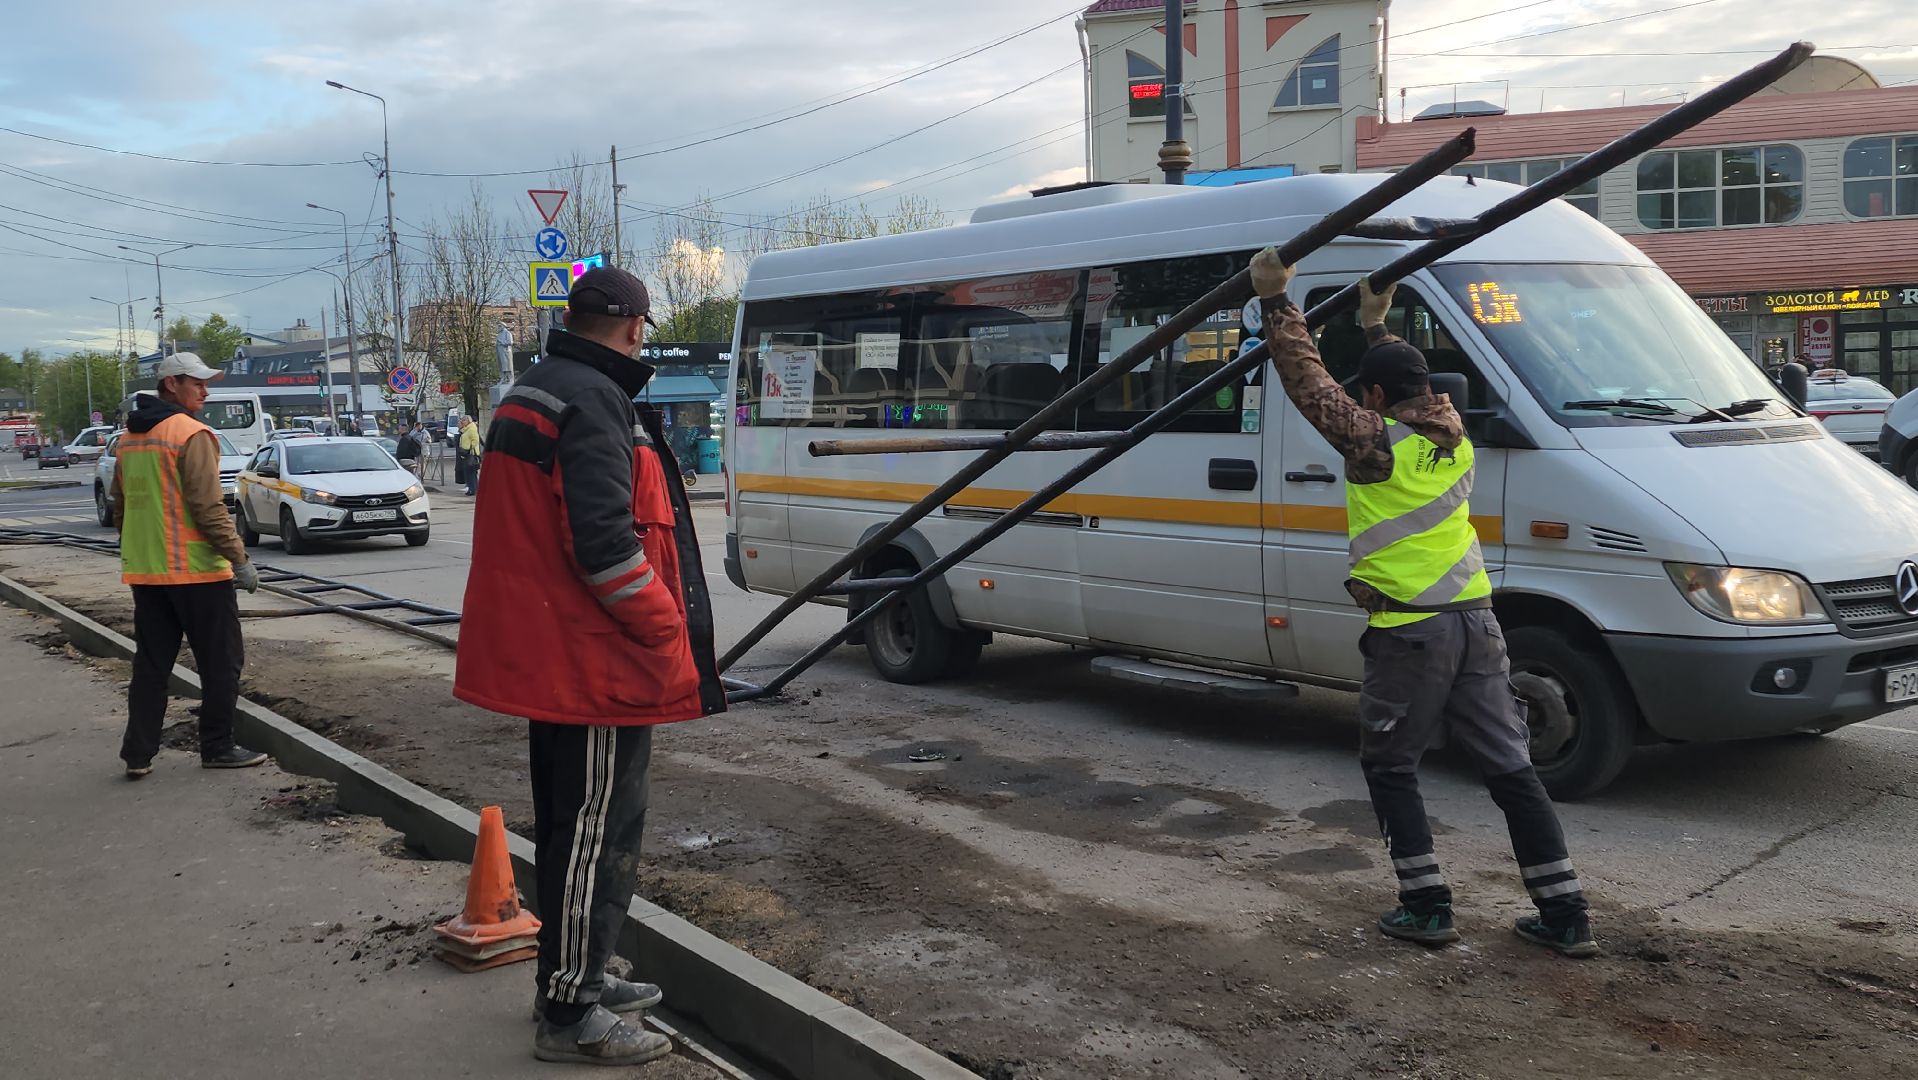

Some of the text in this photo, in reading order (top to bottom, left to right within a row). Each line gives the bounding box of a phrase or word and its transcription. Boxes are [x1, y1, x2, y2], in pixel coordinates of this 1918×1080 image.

[1695, 296, 1748, 314] ЕТЫ
[1765, 289, 1890, 306] ЗОЛОТОЙ ЛЕВ
[662, 347, 690, 357] coffee
